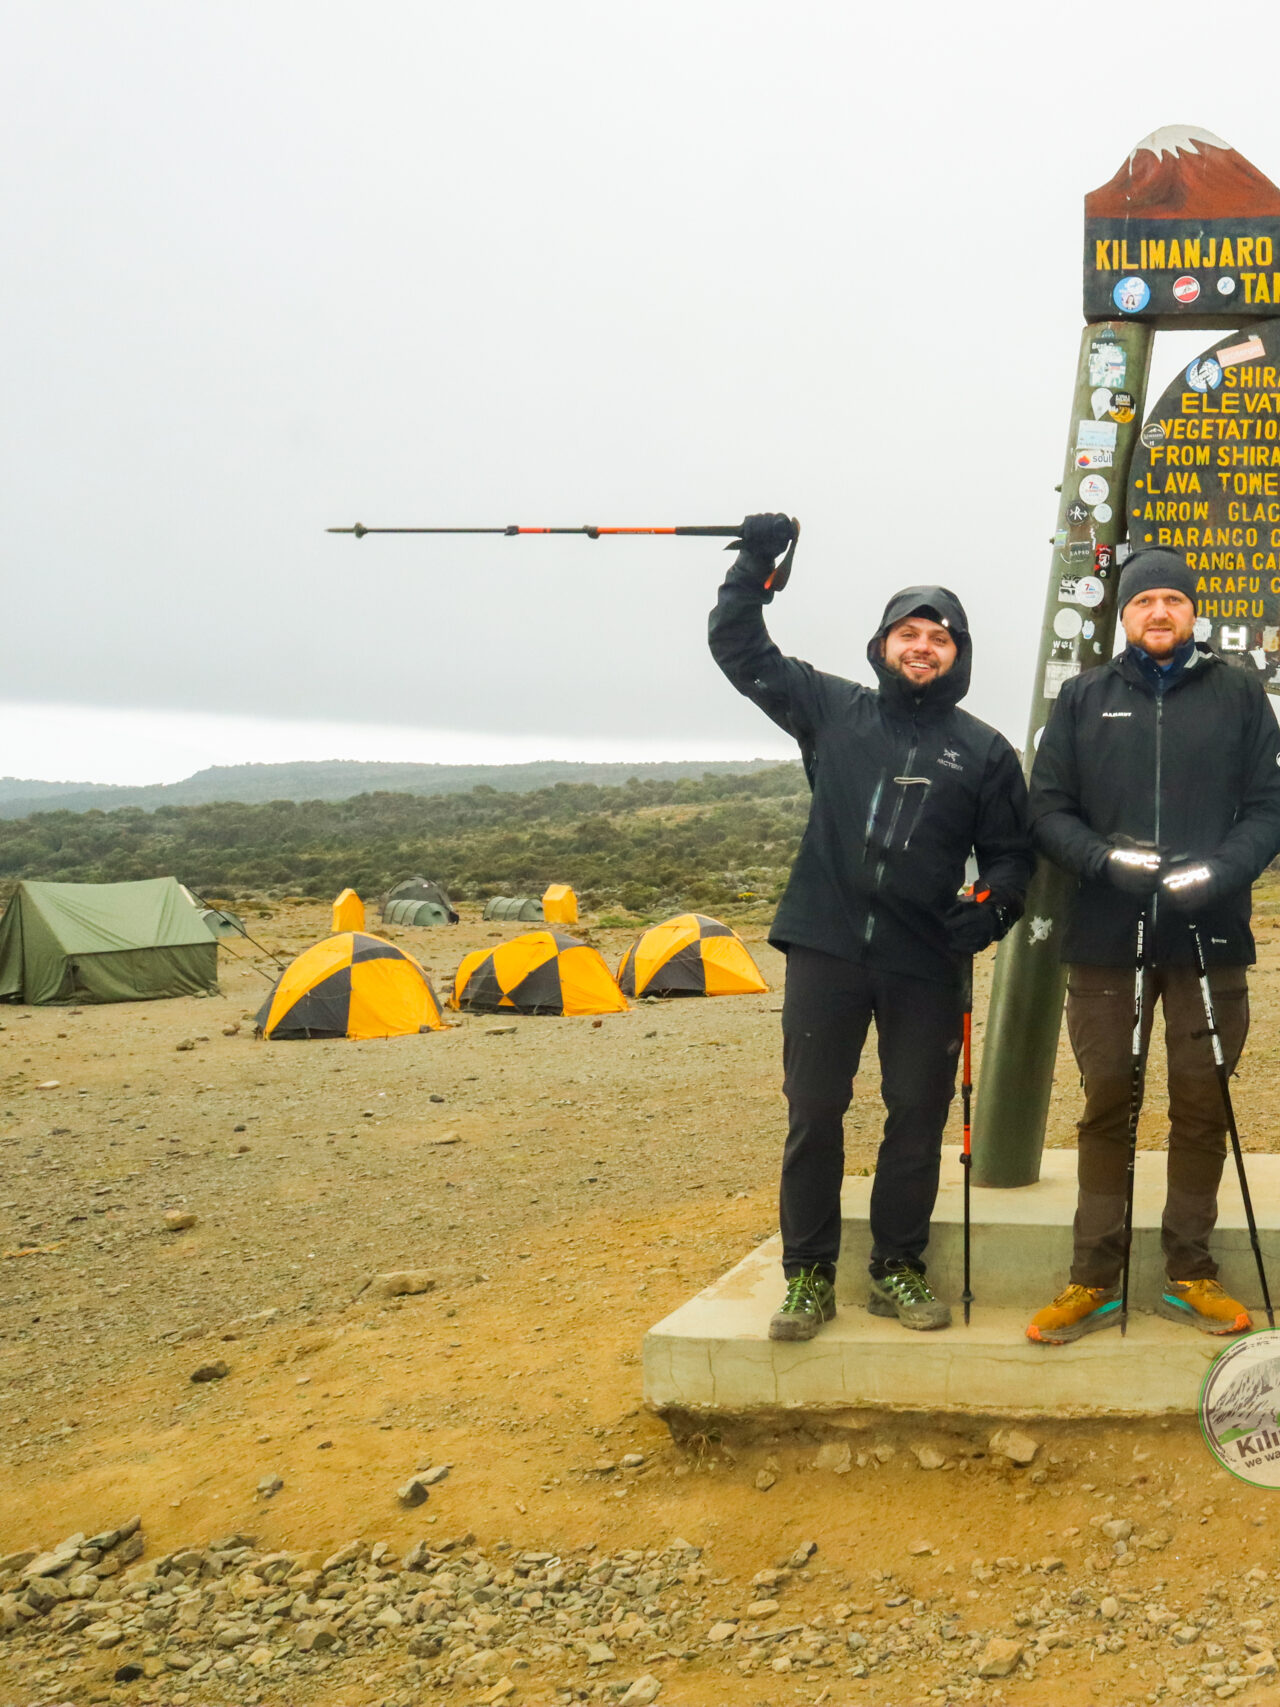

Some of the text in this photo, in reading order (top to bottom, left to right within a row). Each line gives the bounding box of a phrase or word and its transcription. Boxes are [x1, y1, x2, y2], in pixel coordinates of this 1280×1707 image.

[1096, 237, 1272, 270] KILIMANJARO
[1151, 445, 1210, 467] FROM
[1147, 472, 1201, 494] LAVA
[1144, 502, 1209, 521] ARROW
[1159, 528, 1257, 547] BARANCO
[1186, 552, 1247, 571] RANGA
[1196, 576, 1260, 593] ARAFU
